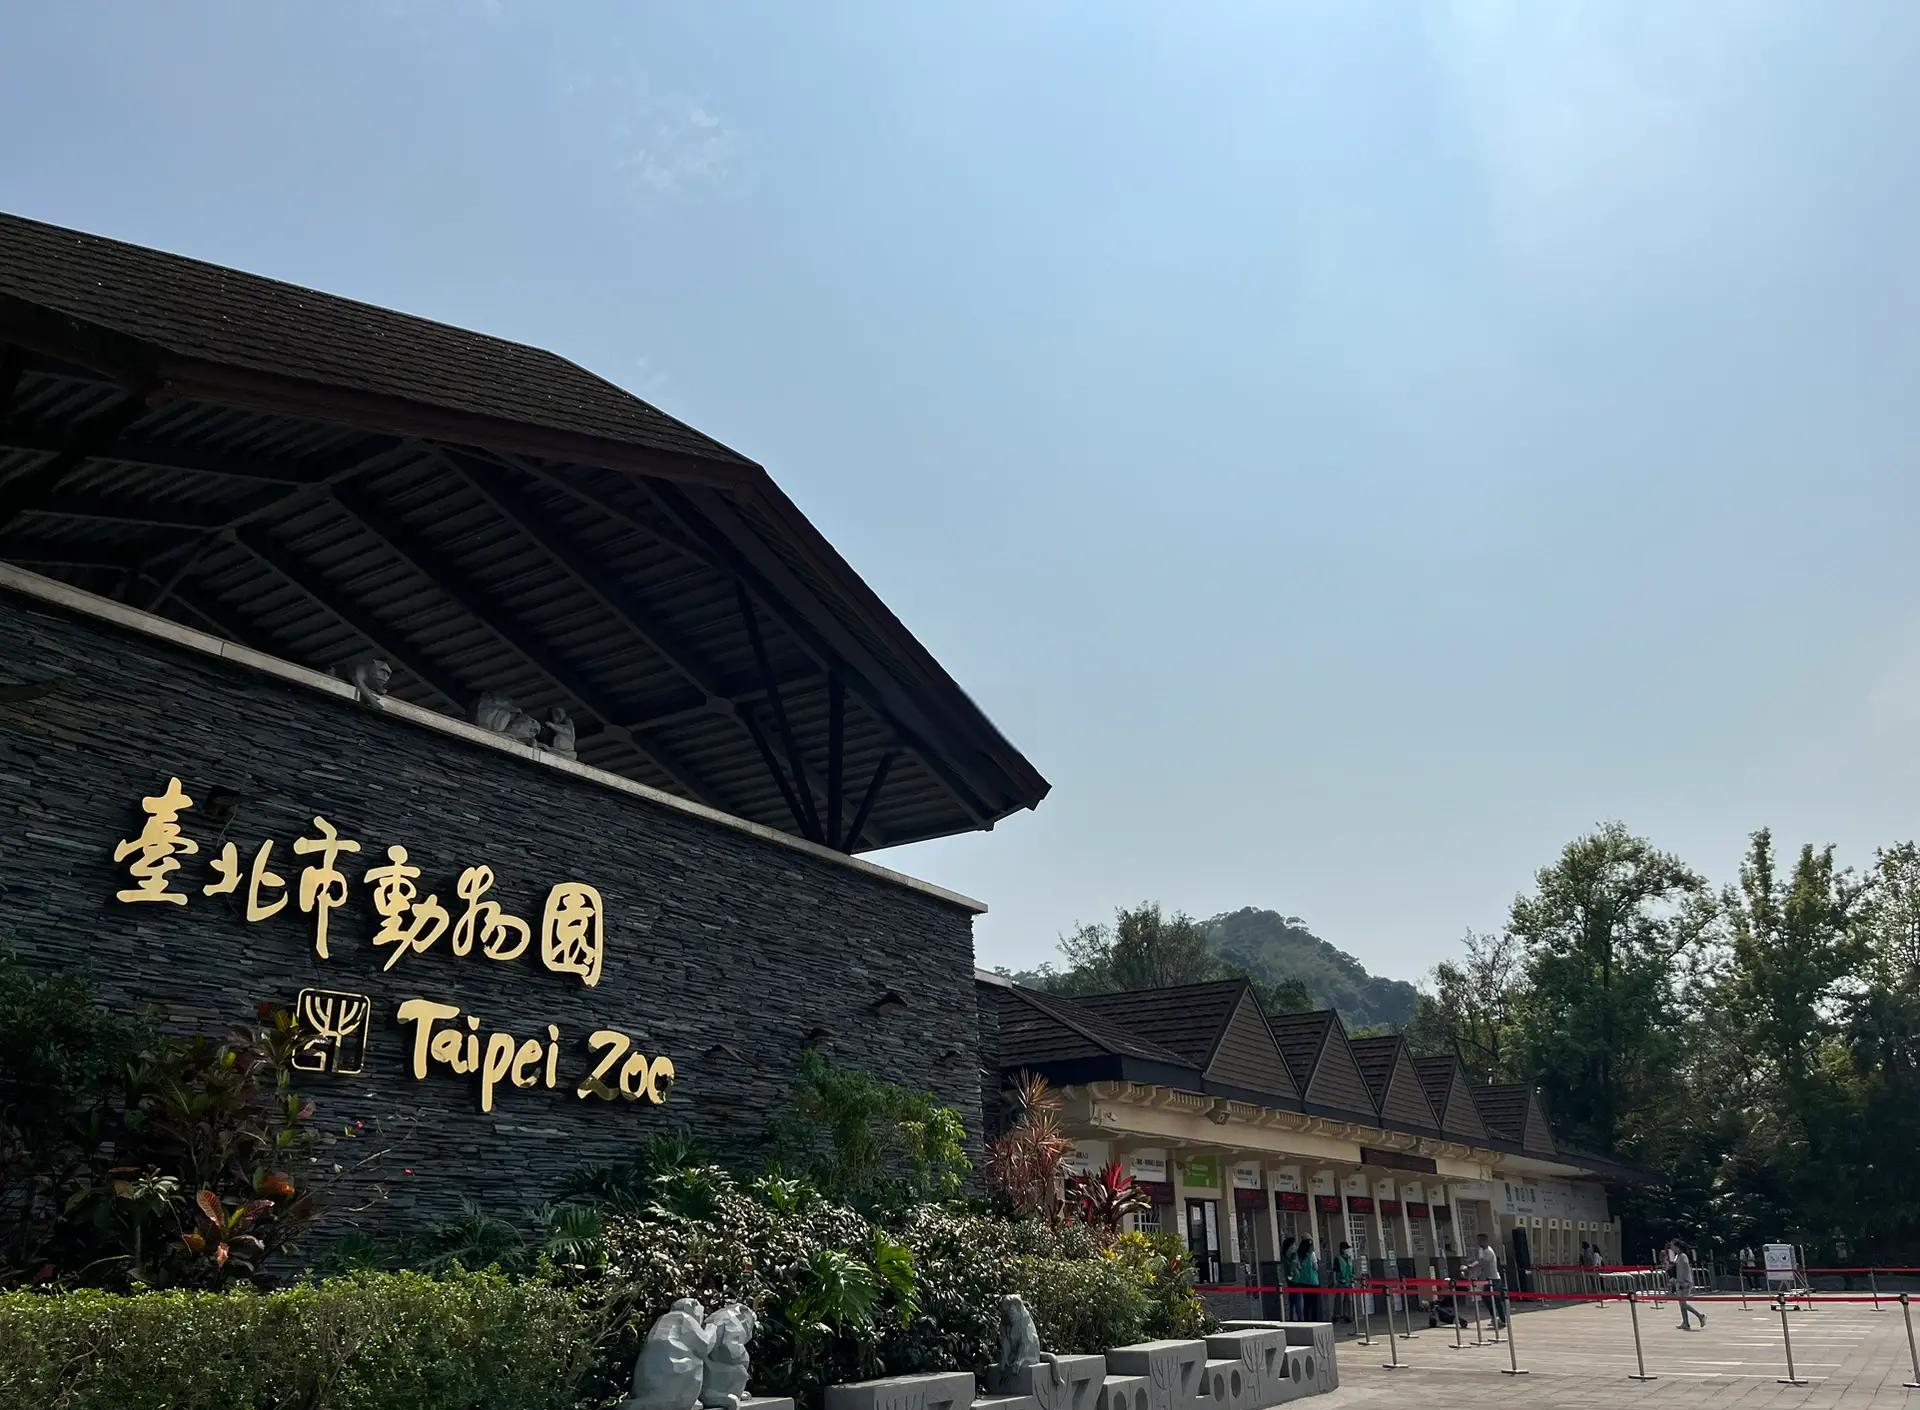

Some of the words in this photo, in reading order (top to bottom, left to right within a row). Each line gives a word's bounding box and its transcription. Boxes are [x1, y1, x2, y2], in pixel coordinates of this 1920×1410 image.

[113, 776, 604, 988] 臺北市動物園
[396, 998, 560, 1113] Taipei
[576, 1030, 675, 1105] Zoo
